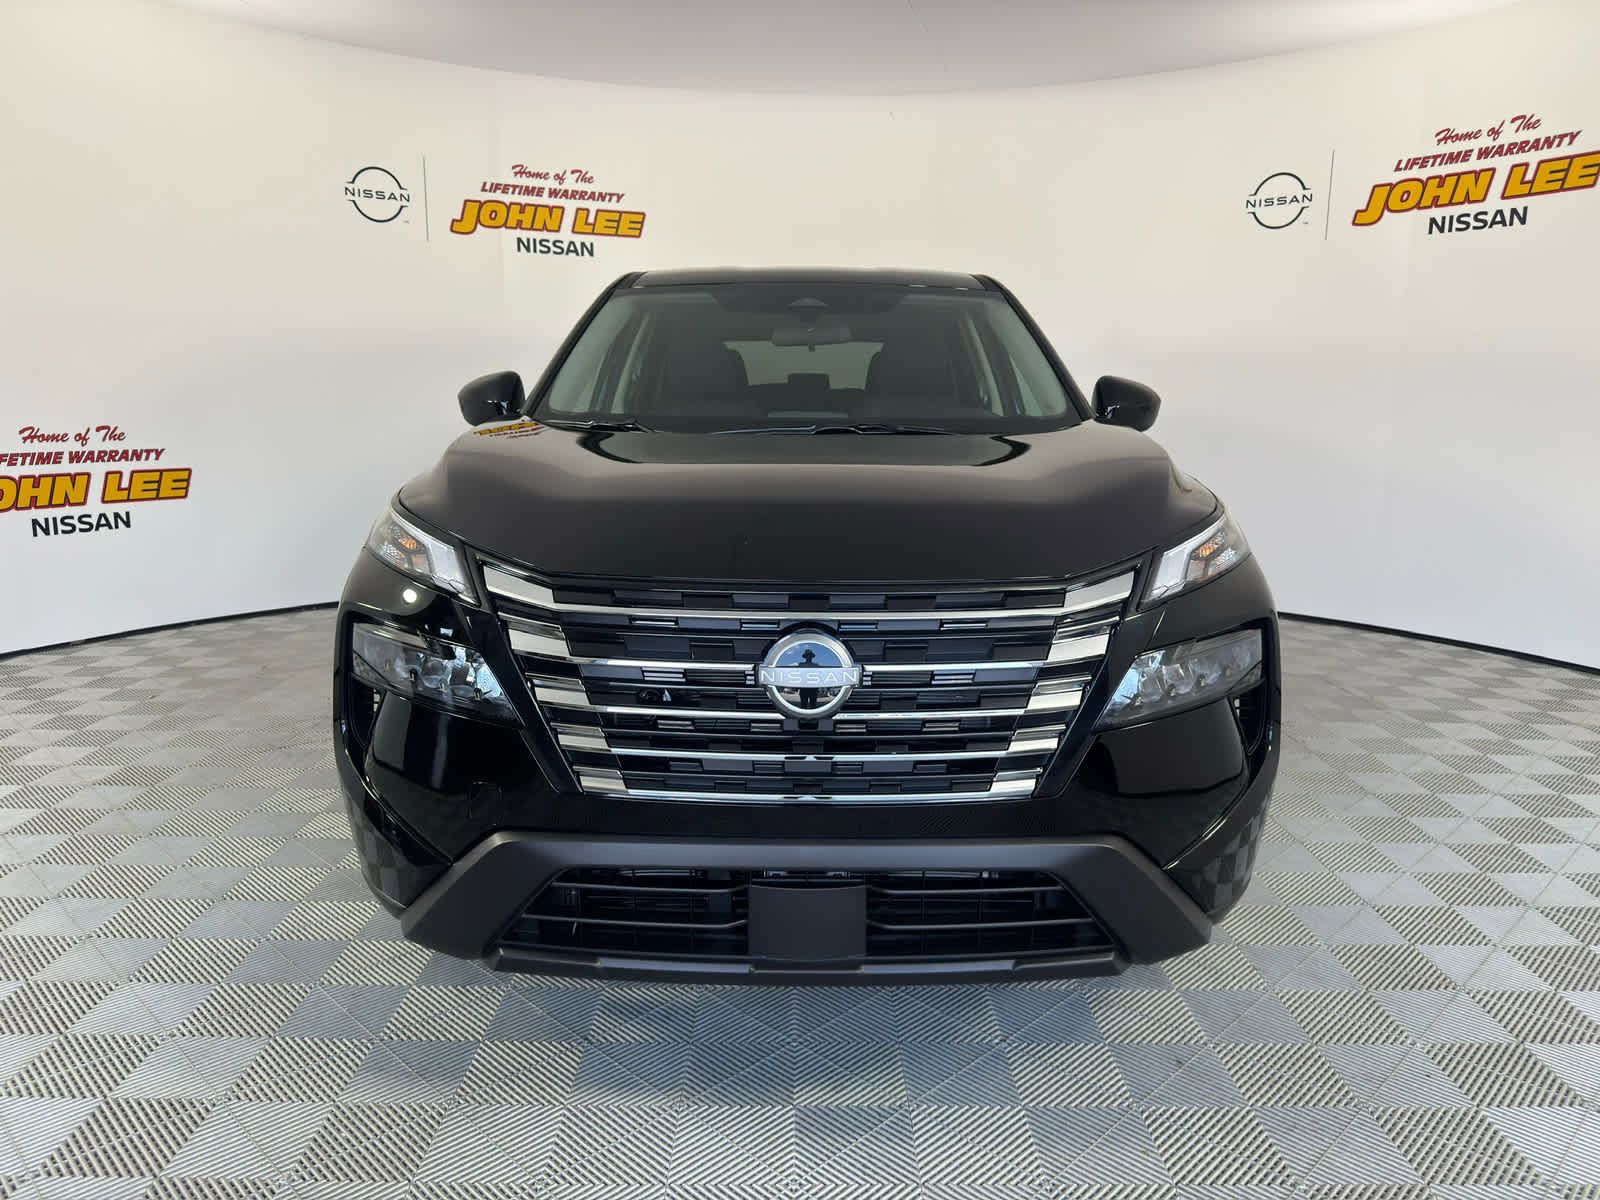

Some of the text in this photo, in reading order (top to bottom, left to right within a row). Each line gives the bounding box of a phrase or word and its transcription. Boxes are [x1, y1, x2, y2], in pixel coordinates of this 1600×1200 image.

[1435, 114, 1541, 145] Home of The
[1394, 130, 1582, 172] LIFETIME WARRANTY
[512, 164, 593, 184] Home of The
[345, 186, 410, 202] NISSAN
[481, 181, 624, 203] LIFETIME WARRANTY
[1352, 150, 1600, 227] JOHN LEE
[1246, 192, 1312, 210] NISSAN
[450, 199, 646, 238] JOHN LEE
[1428, 206, 1528, 235] NISSAN
[517, 237, 594, 257] NISSAN
[19, 425, 126, 447] Home of The
[69, 448, 165, 464] WARRANTY
[101, 468, 192, 504] LEE
[32, 511, 131, 537] NISSAN
[761, 670, 857, 683] NISSAN
